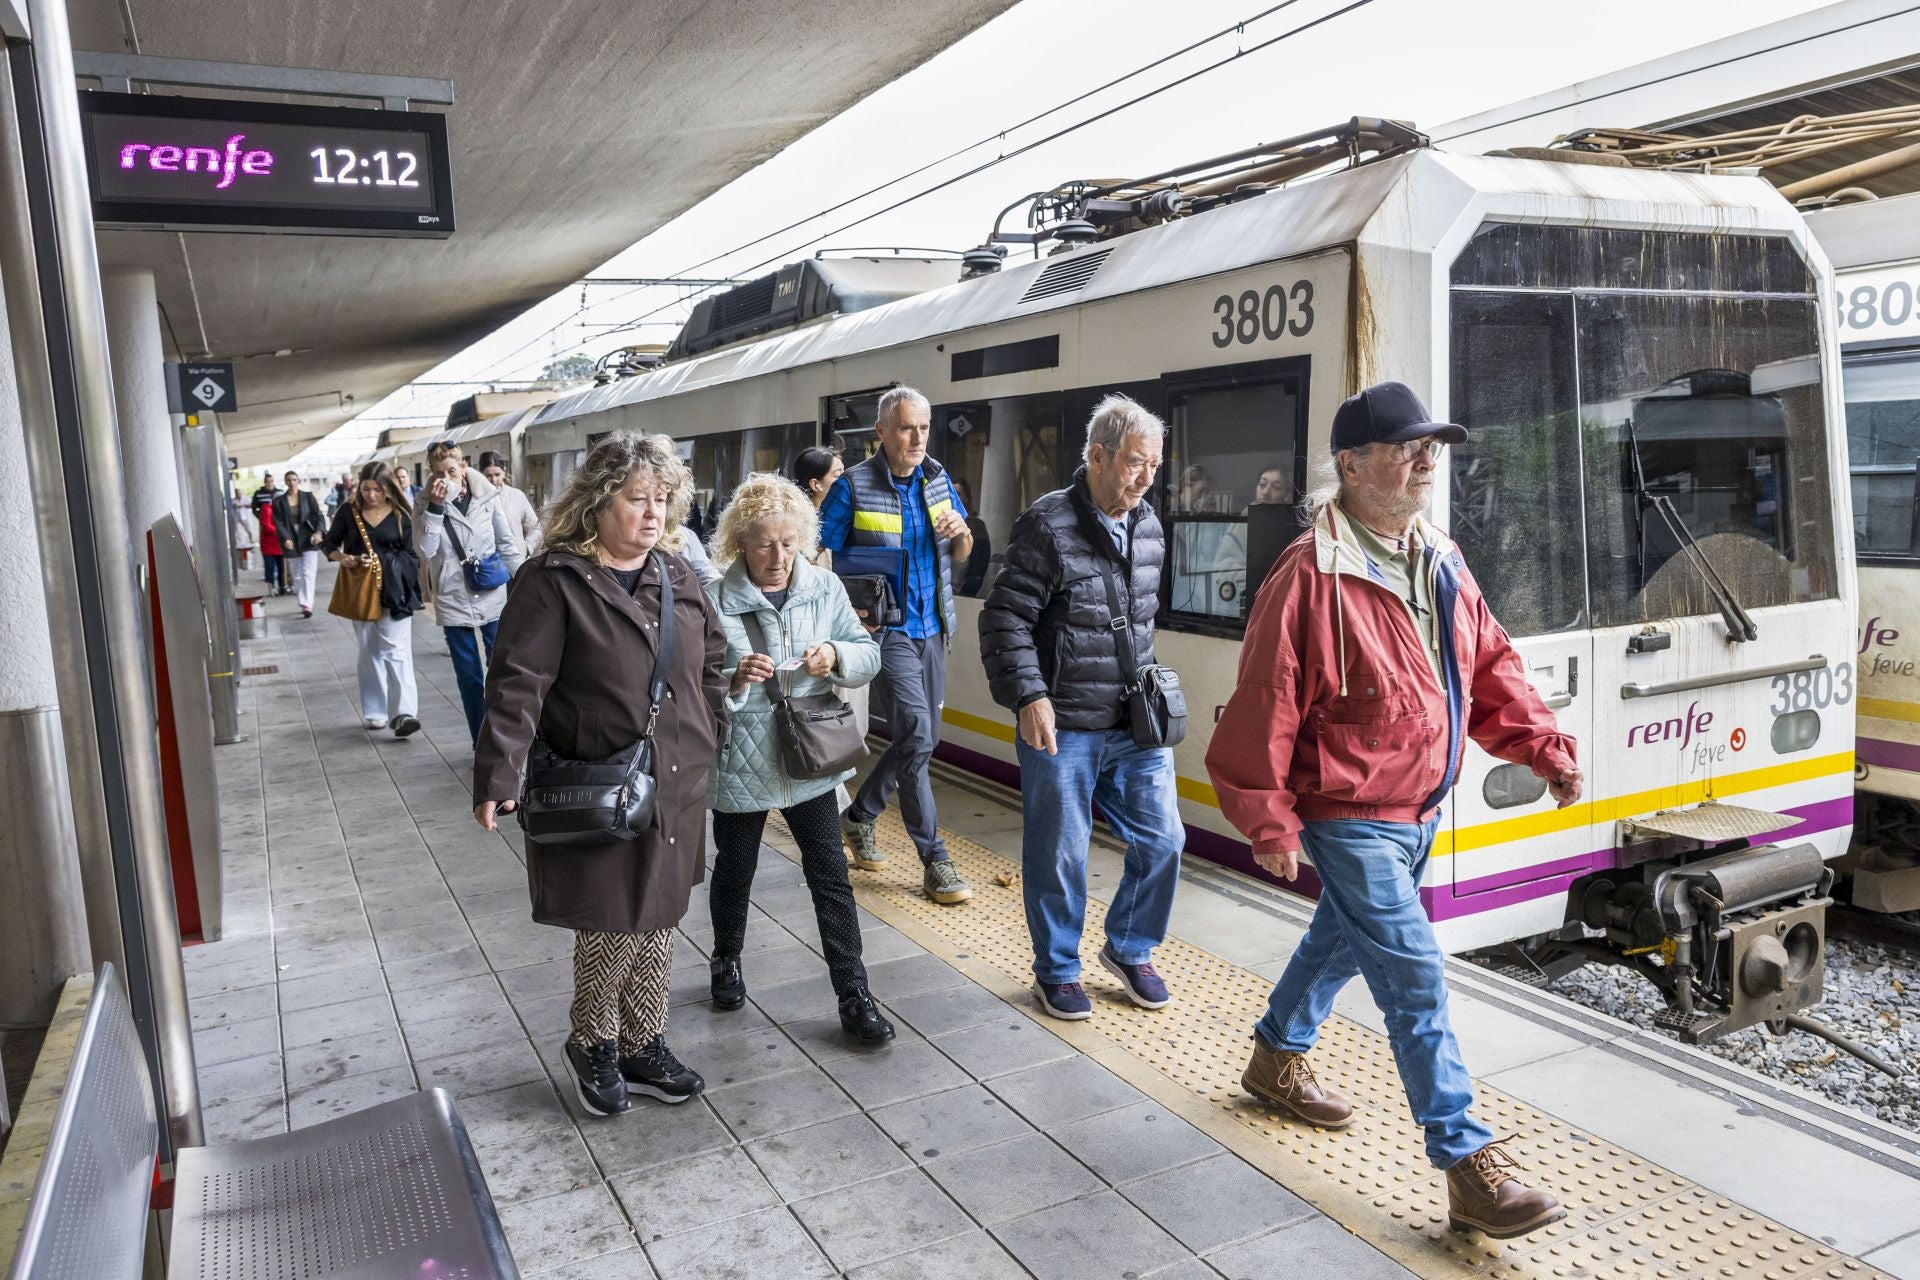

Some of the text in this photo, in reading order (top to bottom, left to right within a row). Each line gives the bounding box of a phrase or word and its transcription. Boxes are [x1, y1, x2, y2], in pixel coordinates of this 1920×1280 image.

[120, 134, 419, 189] renfe 12:12
[1212, 279, 1315, 348] 3803
[1836, 281, 1920, 330] 80
[203, 384, 215, 400] 9
[1858, 616, 1899, 654] fe
[1770, 661, 1853, 717] 3803
[1869, 652, 1915, 677] feve
[1627, 700, 1714, 750] renfe
[1691, 742, 1726, 774] feve
